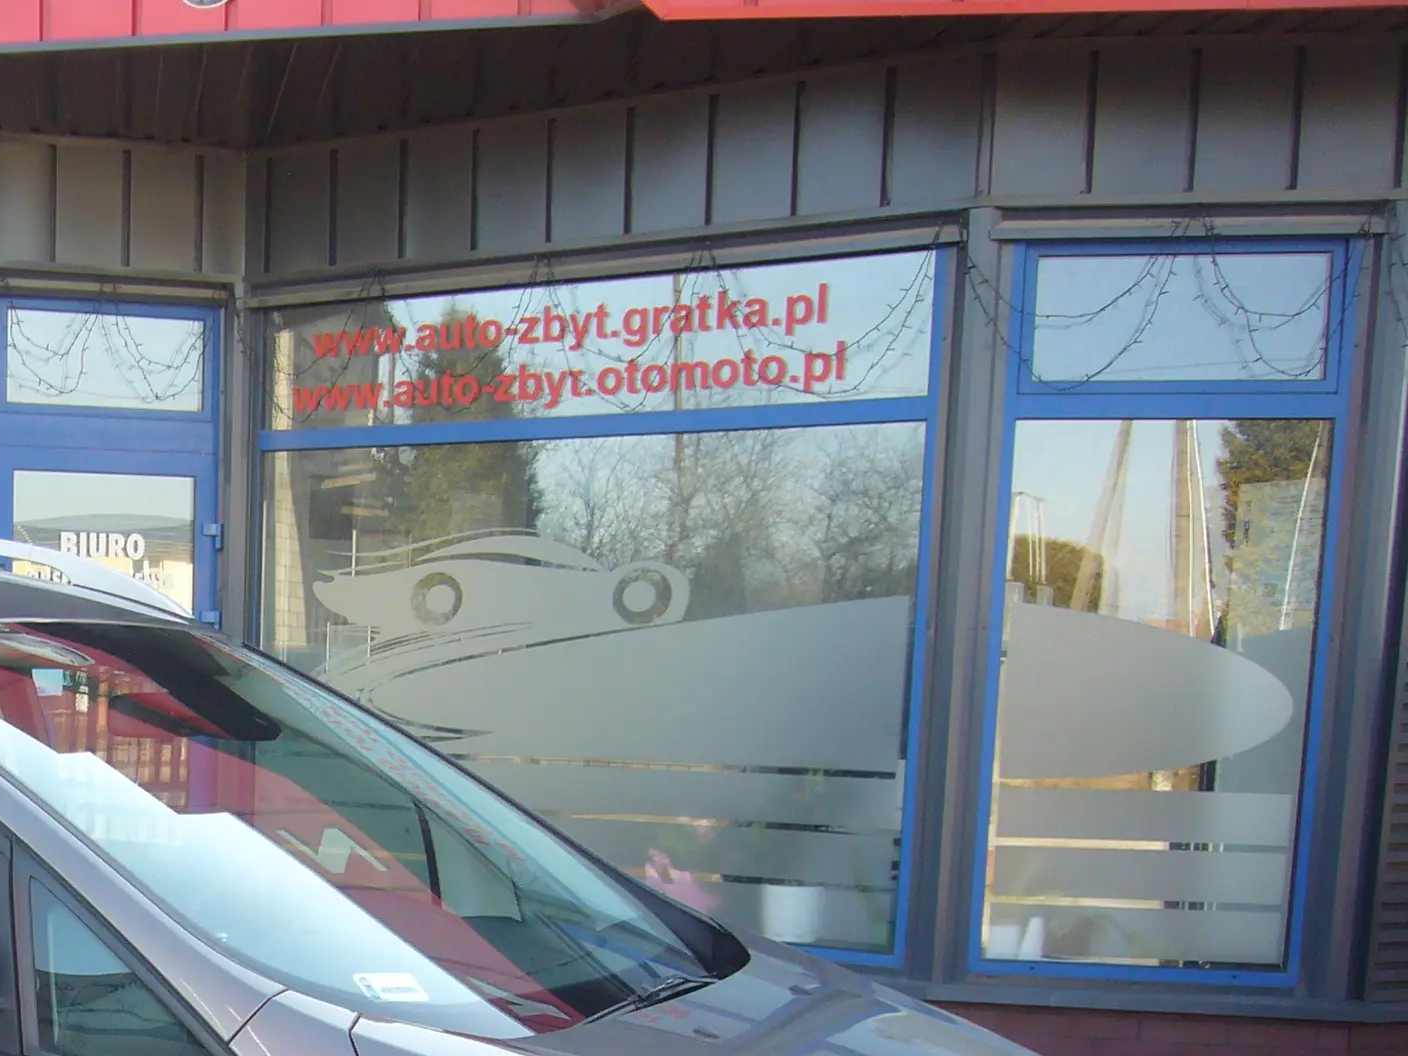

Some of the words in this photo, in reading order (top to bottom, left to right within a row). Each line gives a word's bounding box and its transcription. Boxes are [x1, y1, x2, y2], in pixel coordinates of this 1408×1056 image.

[313, 284, 828, 358] www.auto-zbyt.gratka.pl
[292, 341, 844, 413] www.auto-zbyt.otomoto.pl
[60, 531, 146, 560] BIURO
